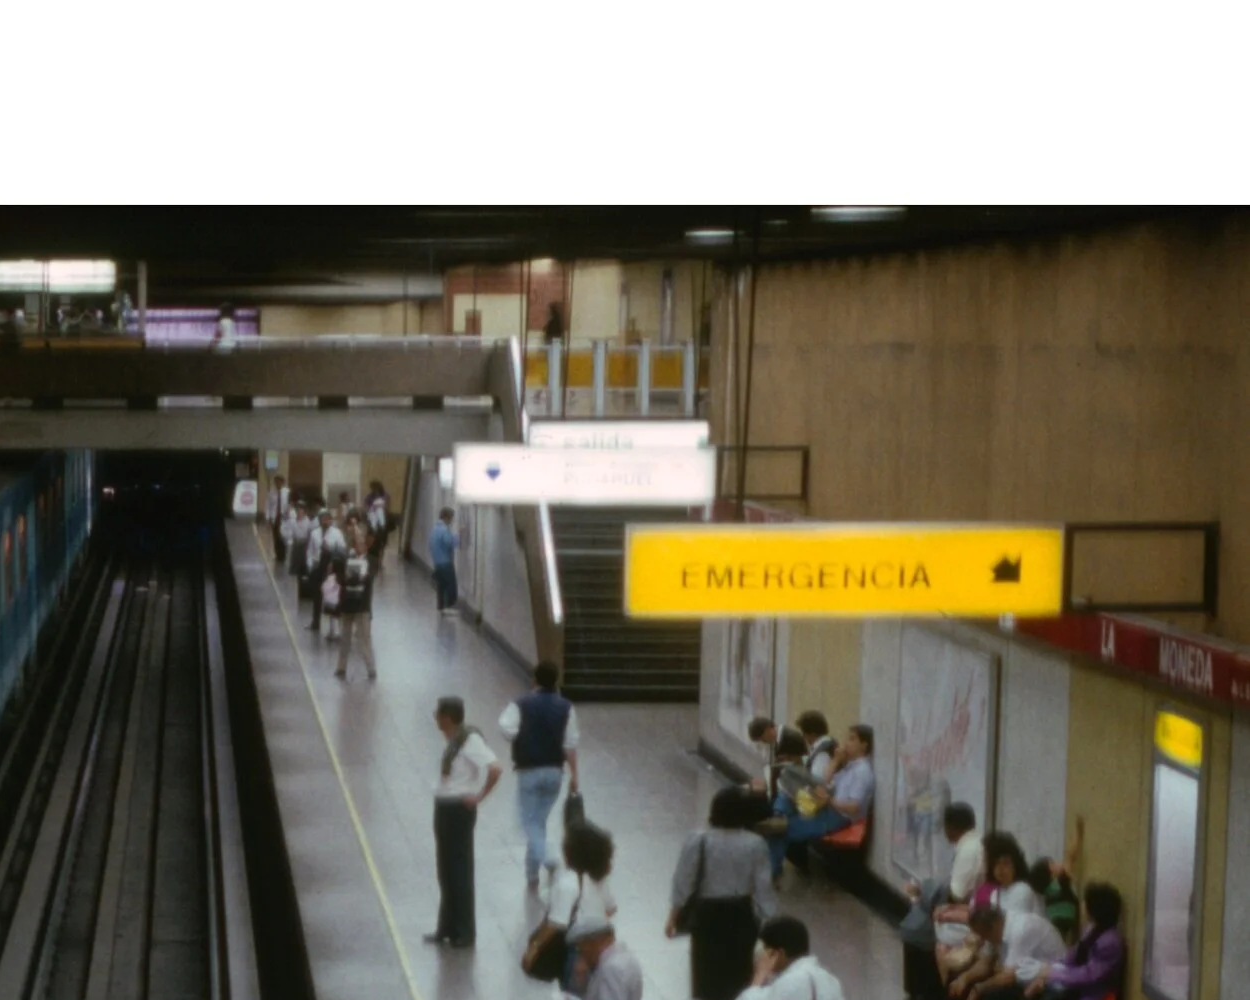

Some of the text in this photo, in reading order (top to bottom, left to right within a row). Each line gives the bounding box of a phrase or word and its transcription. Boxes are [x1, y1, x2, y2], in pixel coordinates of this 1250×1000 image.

[680, 560, 932, 589] EMERGENCIA
[1101, 619, 1115, 660] LA
[1159, 635, 1214, 692] MONEDA
